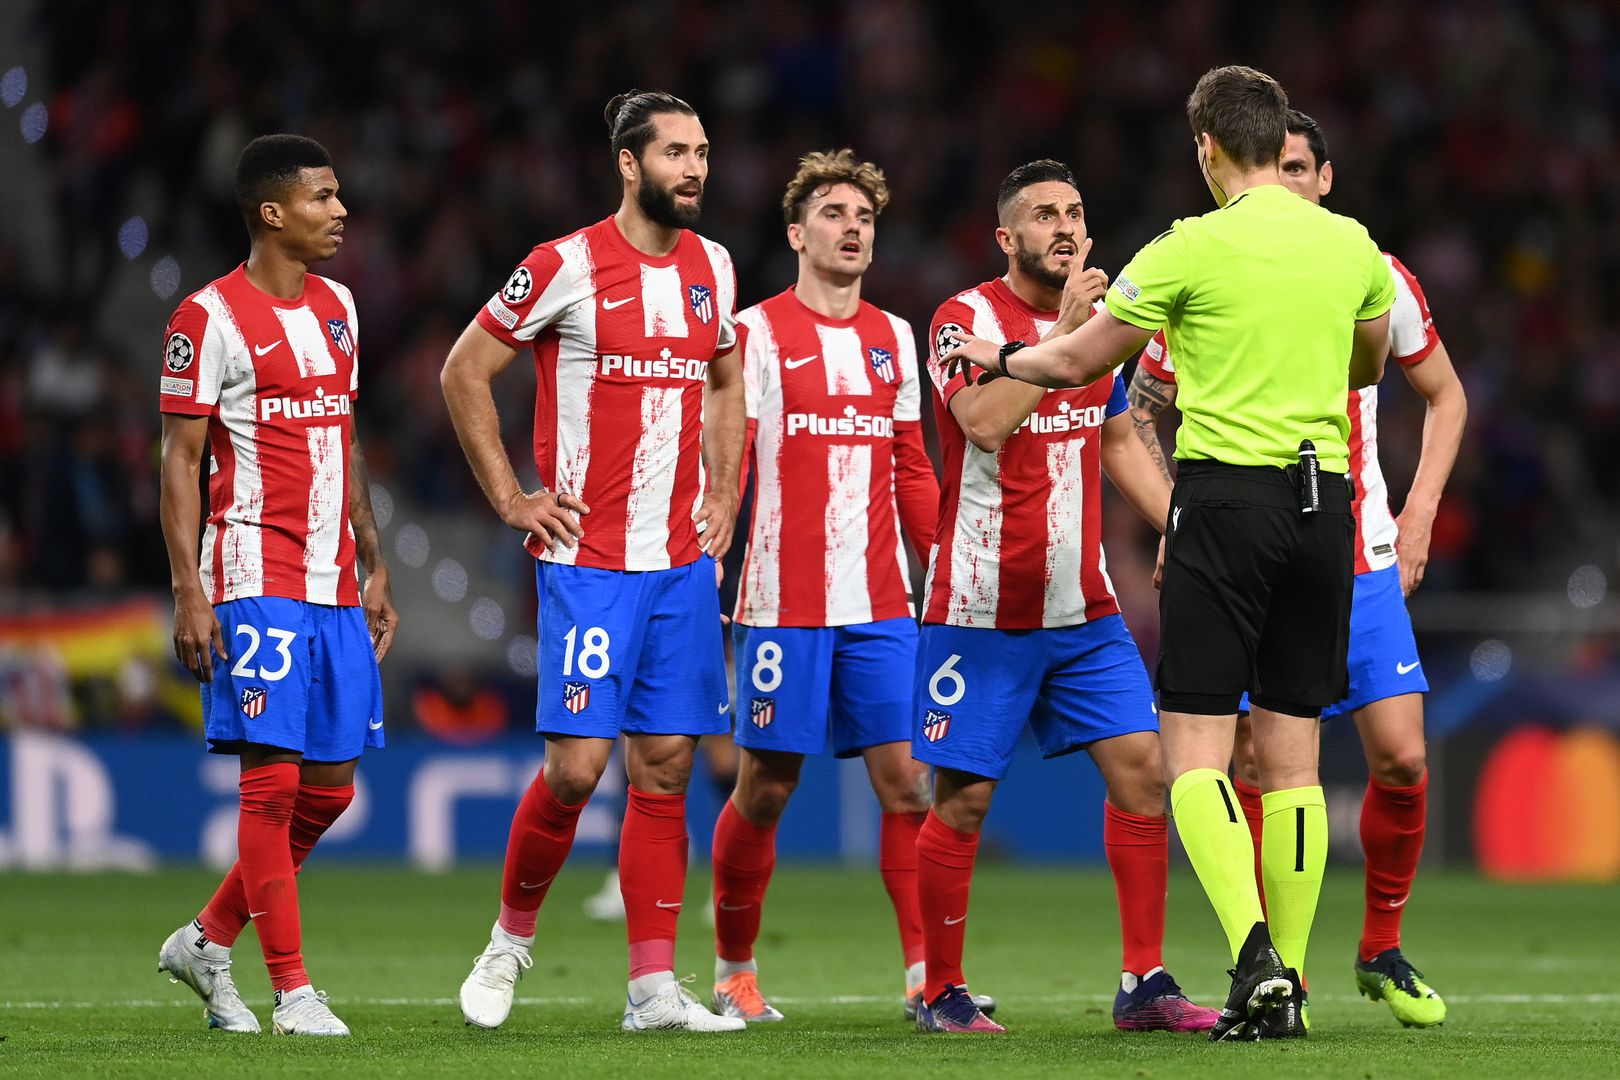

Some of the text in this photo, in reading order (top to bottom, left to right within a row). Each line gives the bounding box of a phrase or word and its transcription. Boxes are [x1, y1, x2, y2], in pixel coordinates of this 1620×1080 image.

[1309, 457, 1319, 505] VANISHING SPRAY
[231, 625, 297, 681] 23
[562, 624, 611, 679] 18
[752, 641, 783, 692] 8
[929, 654, 966, 706] 6
